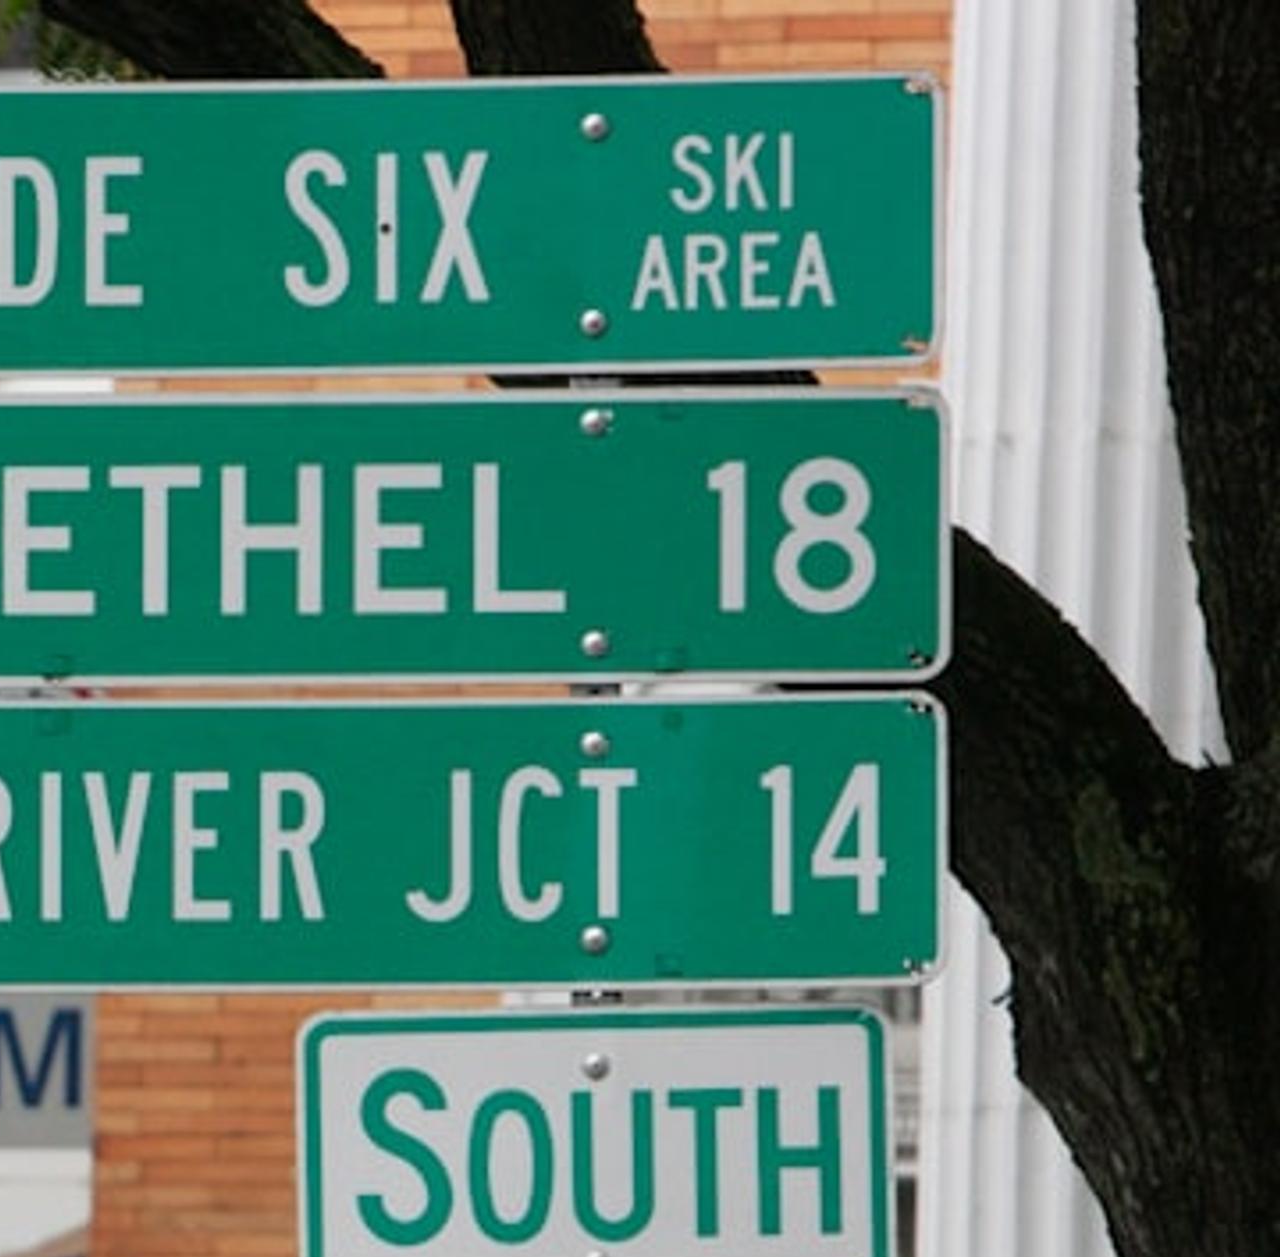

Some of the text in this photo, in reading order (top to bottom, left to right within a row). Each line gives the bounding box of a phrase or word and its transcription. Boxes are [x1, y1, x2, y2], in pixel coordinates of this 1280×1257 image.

[284, 150, 490, 307] SIX
[671, 134, 793, 213] SKI
[632, 232, 836, 311] AREA
[707, 456, 876, 614] 18
[405, 765, 638, 922] JCT
[760, 763, 887, 916] 14
[355, 1067, 844, 1248] SOUTH
